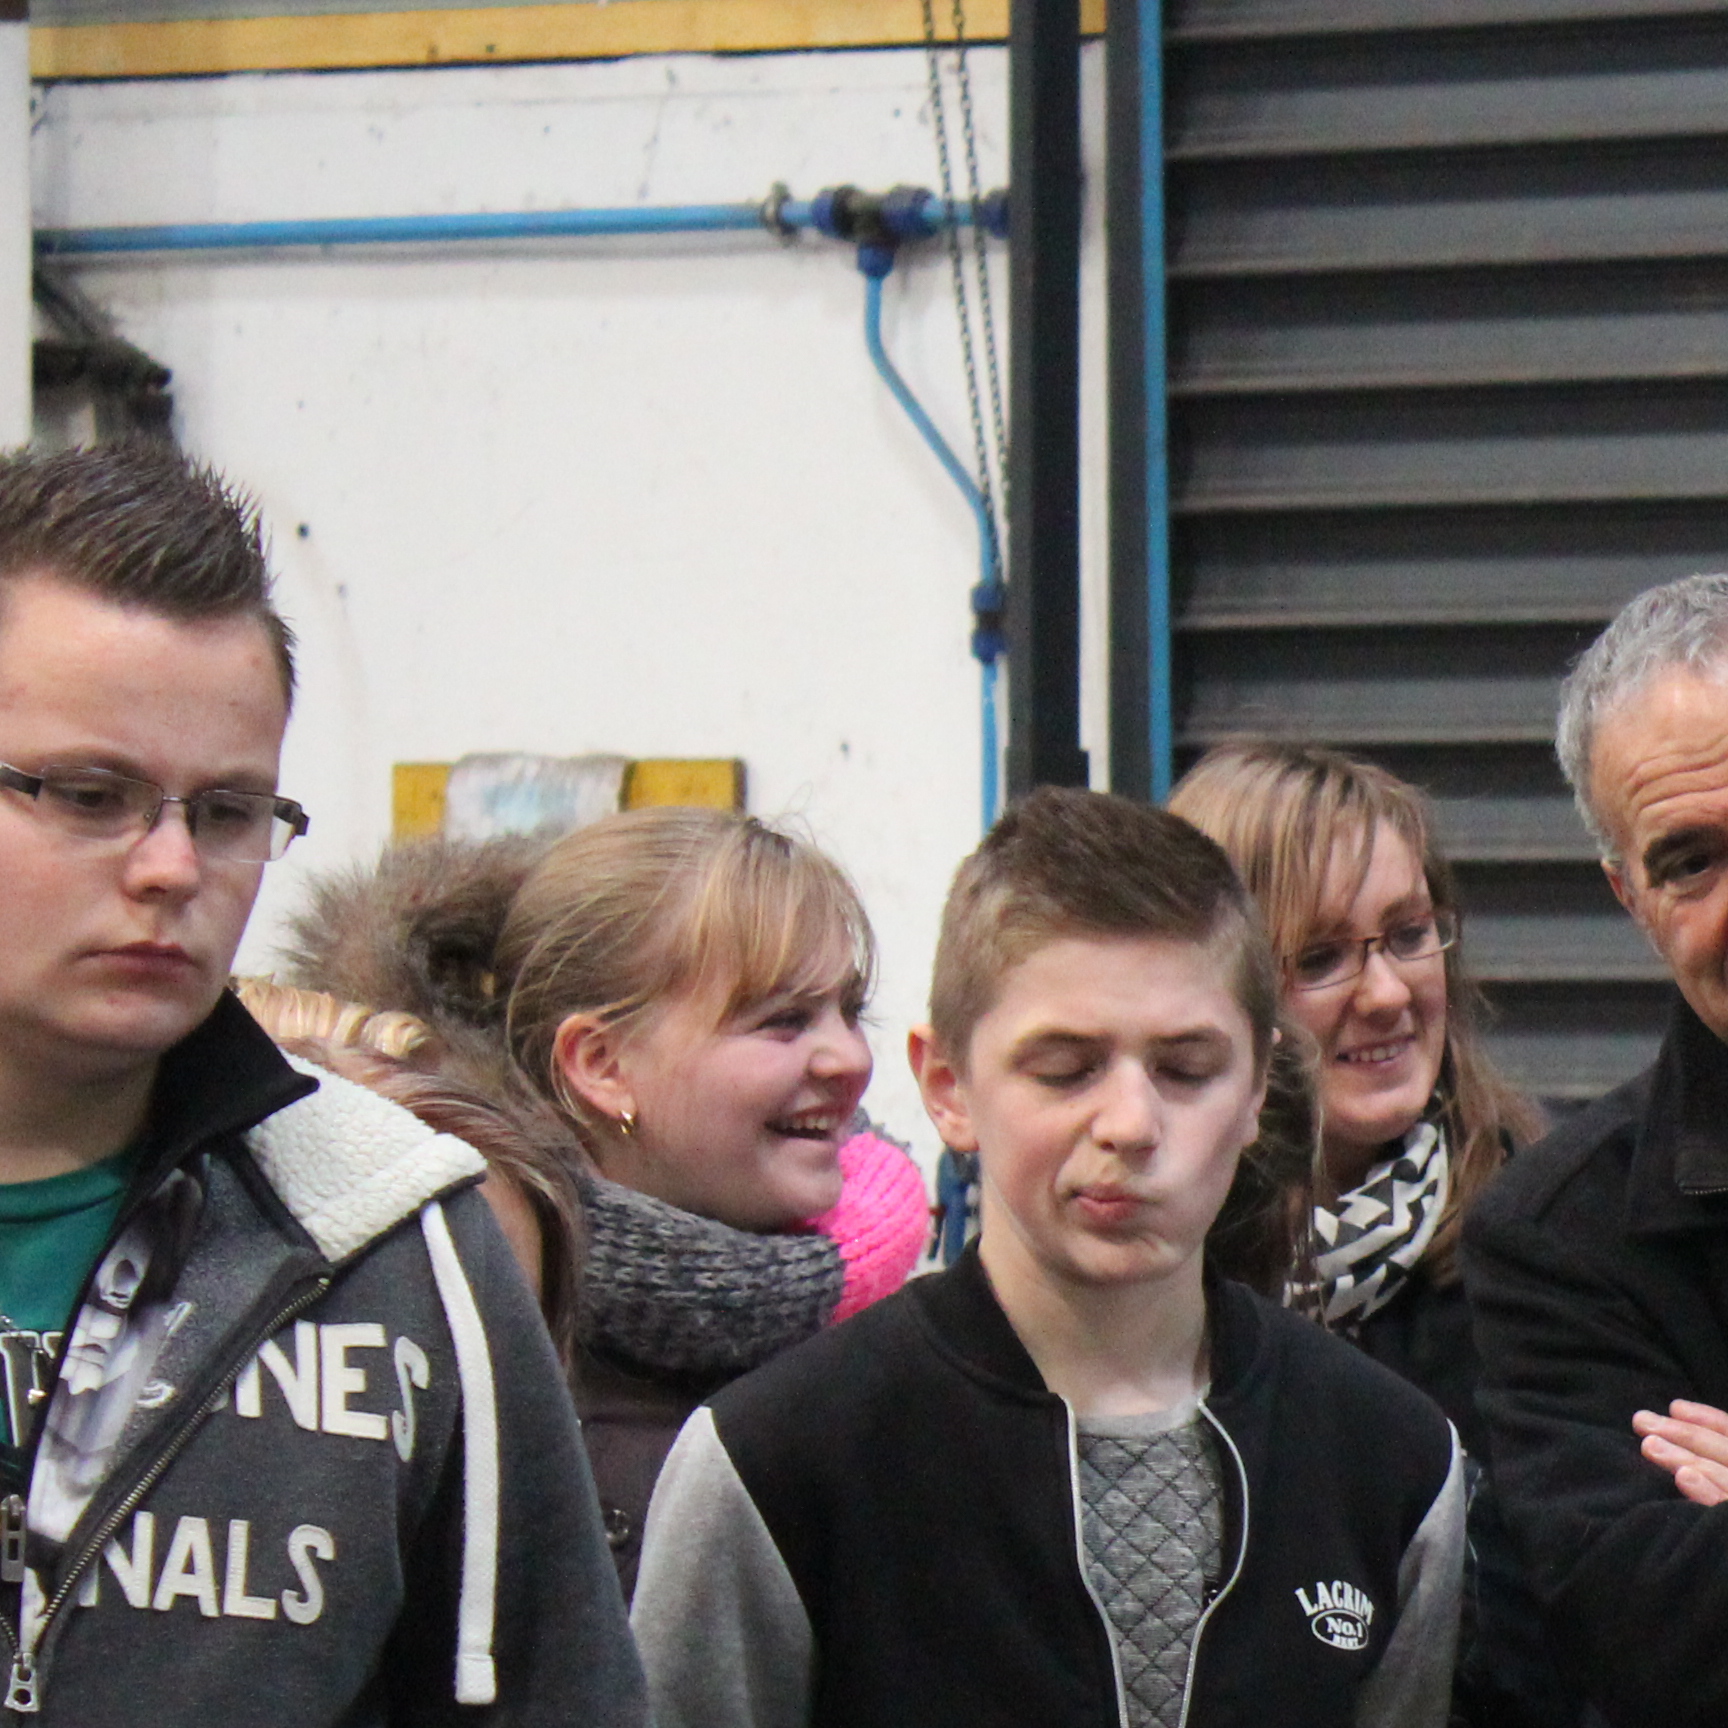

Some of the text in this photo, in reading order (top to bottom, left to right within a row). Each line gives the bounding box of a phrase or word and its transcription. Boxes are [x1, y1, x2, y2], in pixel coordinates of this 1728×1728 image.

[209, 1318, 430, 1462] NES
[79, 1510, 335, 1625] NALS
[1294, 1580, 1375, 1625] LACRIM
